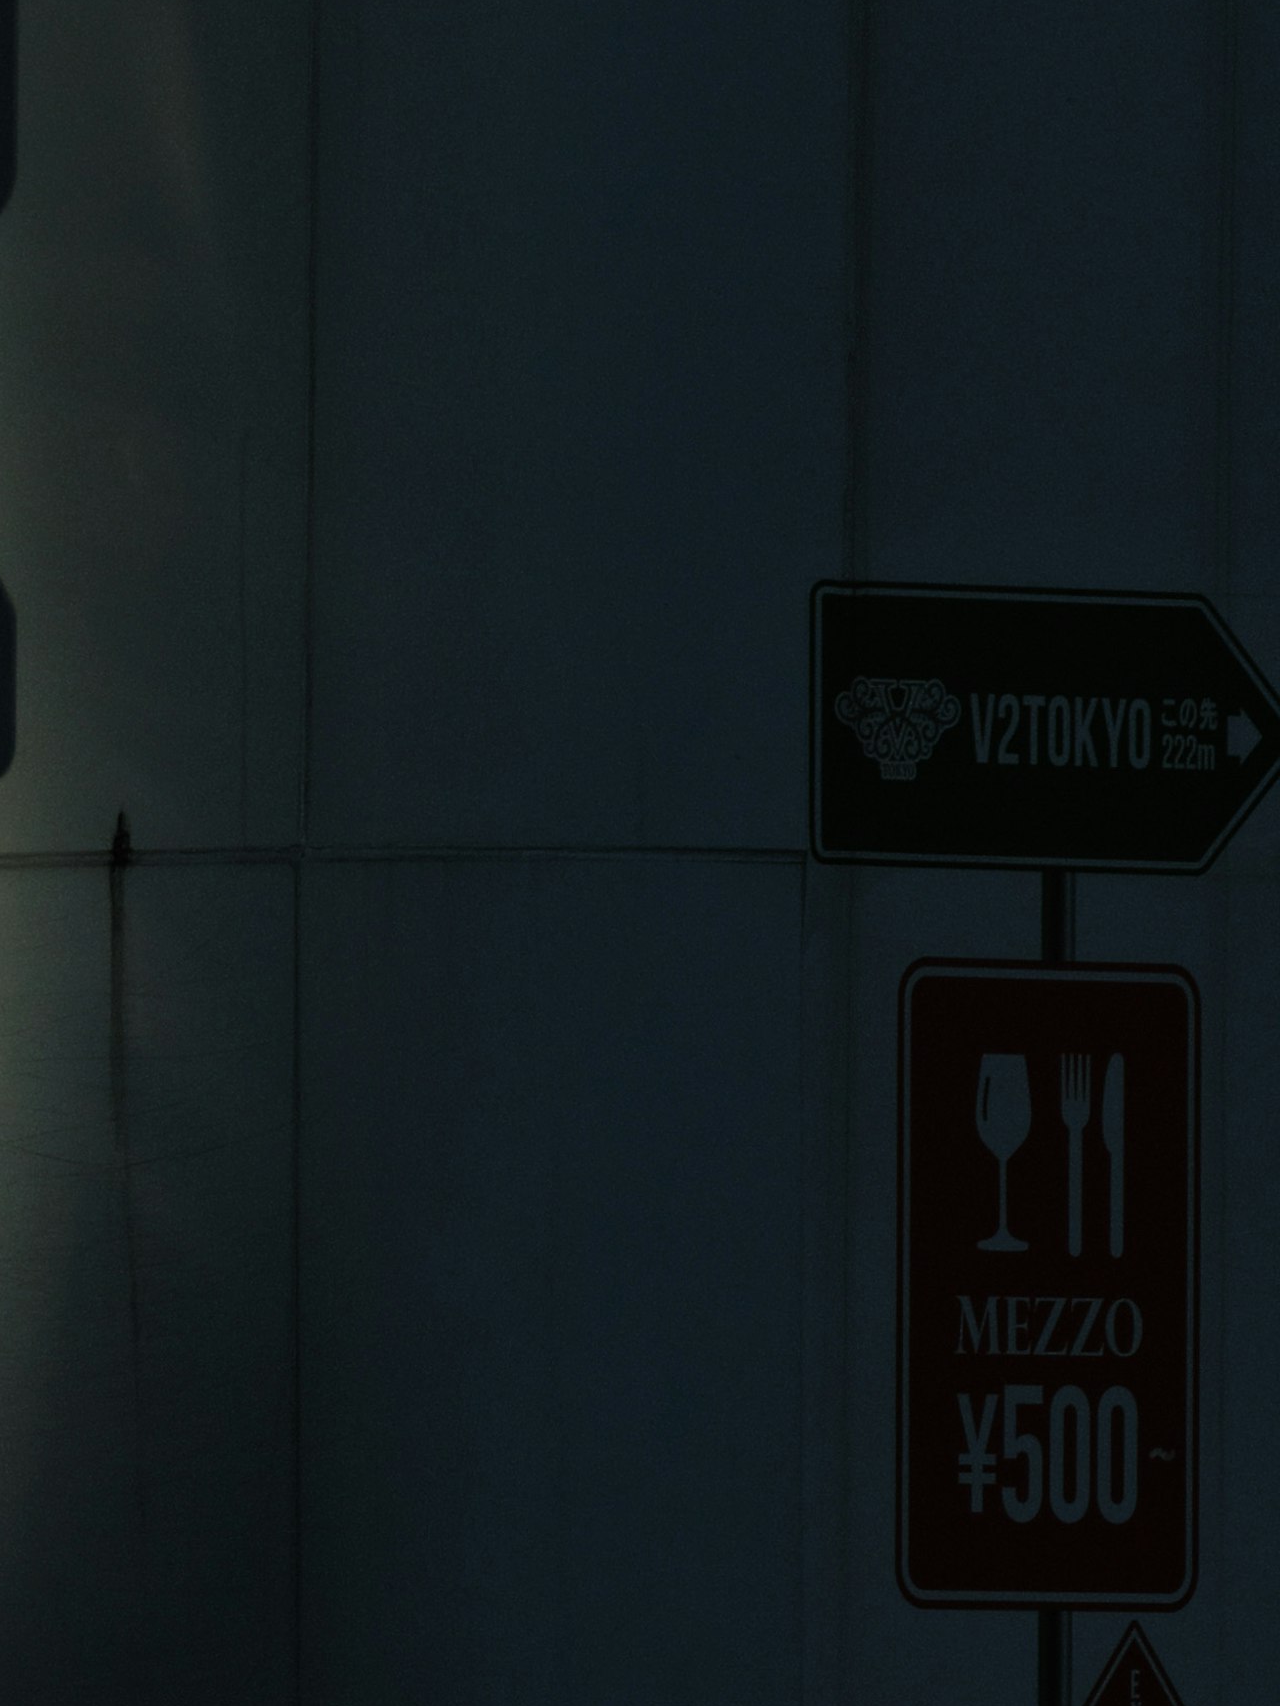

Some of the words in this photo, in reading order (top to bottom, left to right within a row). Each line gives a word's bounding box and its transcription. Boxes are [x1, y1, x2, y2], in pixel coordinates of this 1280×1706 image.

[969, 692, 1152, 770] V2TOKYO
[1160, 696, 1219, 731] この先
[1160, 733, 1216, 771] 222m
[955, 1295, 1144, 1358] MEZZO
